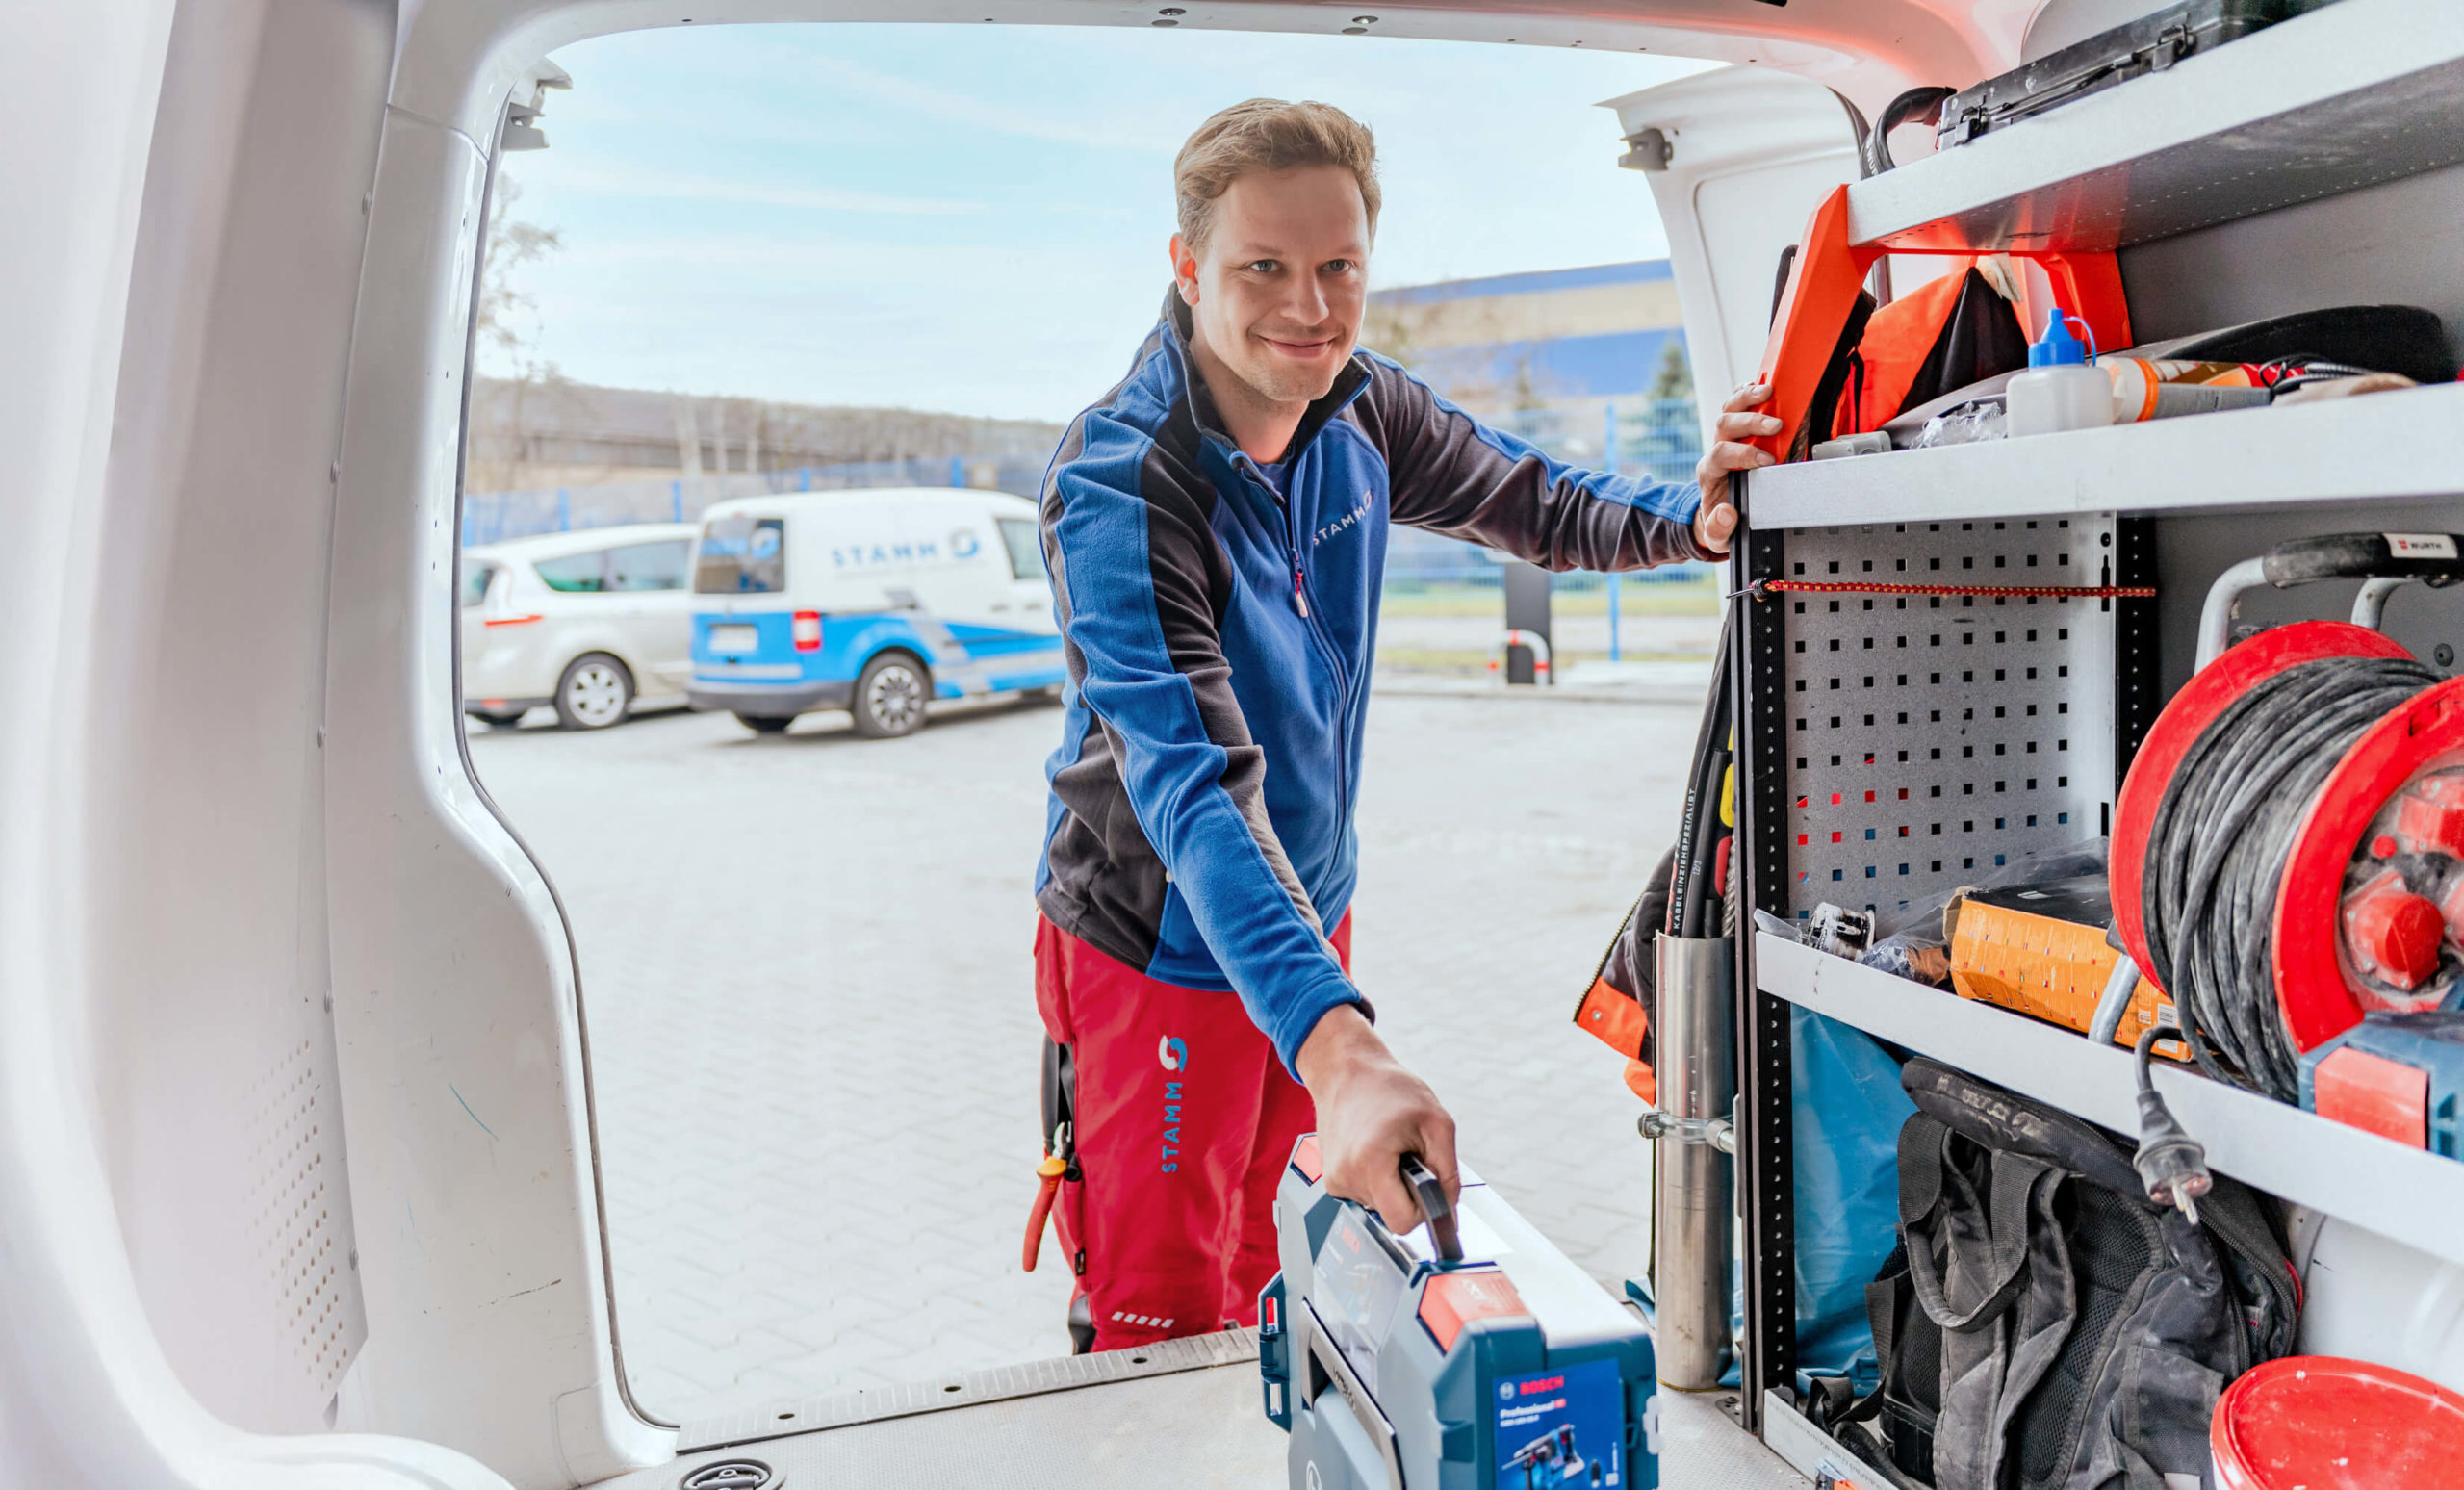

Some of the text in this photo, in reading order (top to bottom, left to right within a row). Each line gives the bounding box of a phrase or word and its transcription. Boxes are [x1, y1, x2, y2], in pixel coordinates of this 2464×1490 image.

[1313, 505, 1366, 546] STAMM
[1673, 787, 1696, 931] KABELEINZIEHSPEZIALIST
[1162, 1082, 1183, 1173] STAMM
[1520, 1375, 1564, 1395] BOSCH
